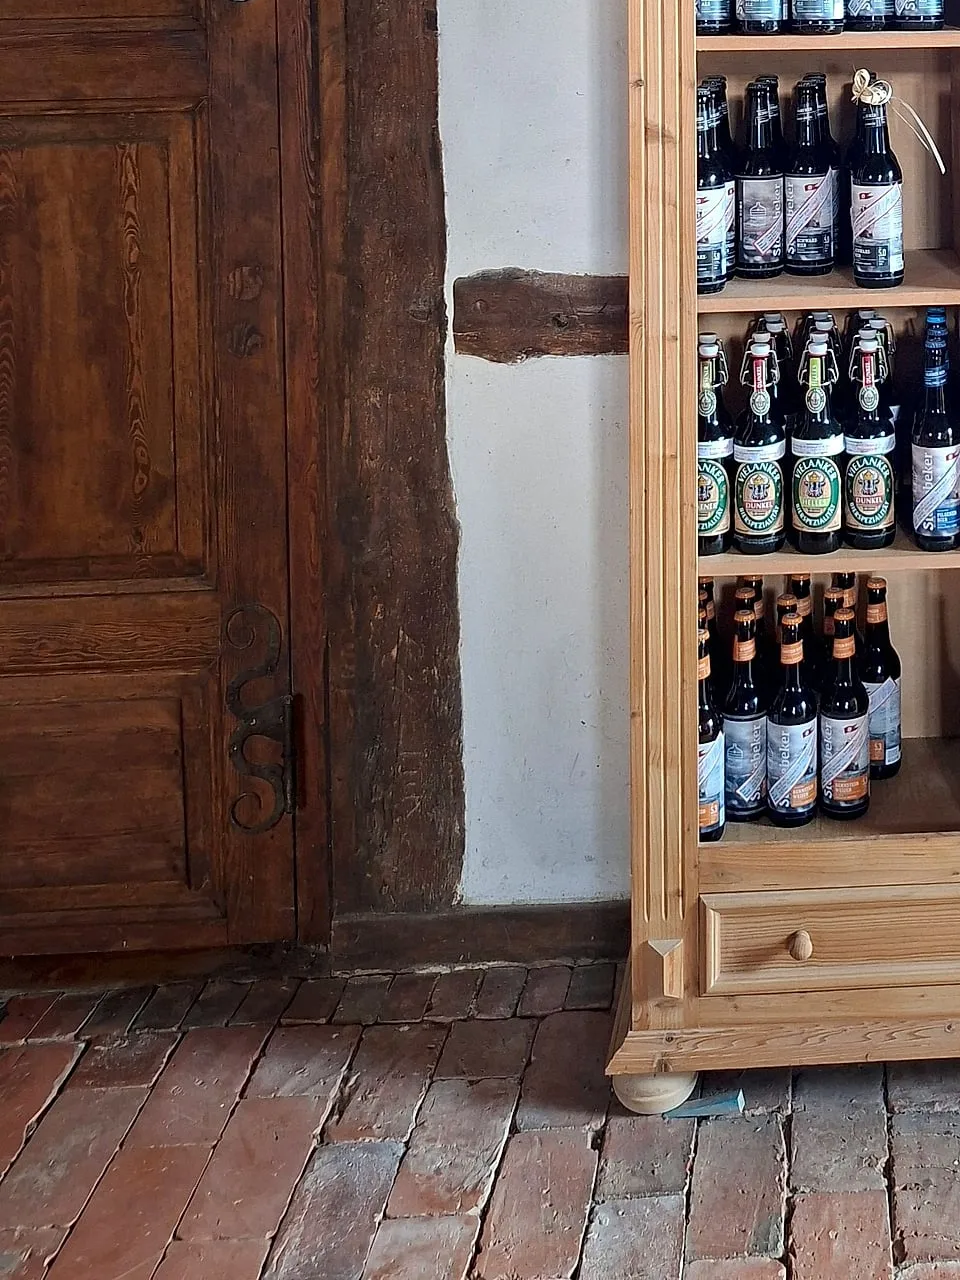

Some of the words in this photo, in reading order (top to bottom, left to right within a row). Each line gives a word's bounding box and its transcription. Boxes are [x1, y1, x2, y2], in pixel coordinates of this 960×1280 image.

[738, 462, 780, 483] VIELANKER
[794, 458, 837, 481] VIELANKER
[848, 456, 890, 478] VIELANKER
[745, 502, 774, 510] DUNKEL
[855, 496, 884, 504] DUNKEL
